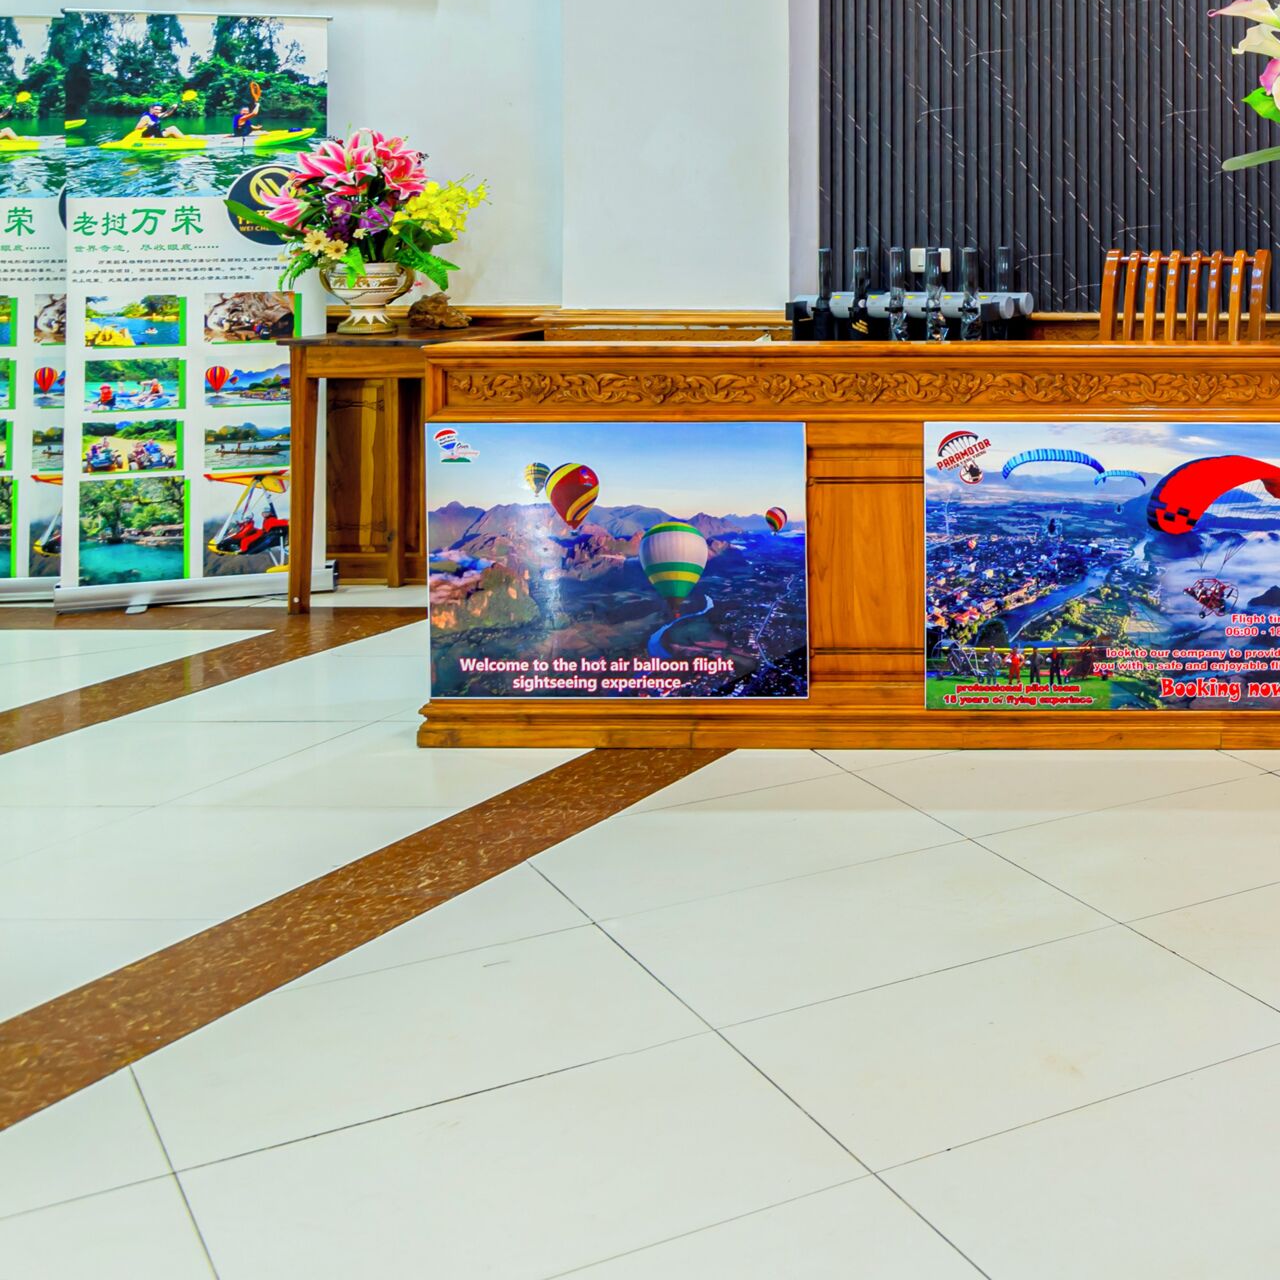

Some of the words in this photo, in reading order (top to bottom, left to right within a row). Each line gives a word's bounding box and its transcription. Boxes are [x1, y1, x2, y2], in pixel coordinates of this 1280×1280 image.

[4, 206, 35, 236] 荣
[73, 205, 203, 236] 老挝万荣
[936, 438, 991, 471] PARAMOTOR
[1232, 614, 1266, 624] Flight
[1226, 627, 1258, 636] 06:00
[1107, 648, 1132, 658] look
[1134, 649, 1147, 658] to
[1150, 650, 1169, 658] our
[1173, 649, 1226, 659] company
[1229, 649, 1241, 658] to
[460, 658, 528, 672] Welcome
[533, 659, 549, 672] to
[553, 658, 577, 672] the
[581, 658, 606, 672] hot
[610, 658, 630, 672] air
[634, 657, 688, 672] balloon
[693, 657, 734, 674] flight
[1094, 663, 1115, 672] you
[1118, 661, 1144, 670] with
[1147, 663, 1155, 671] a
[1158, 661, 1182, 671] safe
[1185, 661, 1207, 671] and
[1210, 661, 1267, 672] enjoyable
[513, 676, 597, 692] sightseeing
[956, 683, 1023, 694] professional
[1025, 684, 1049, 694] pilot
[1052, 684, 1080, 693] team
[1161, 678, 1241, 702] Booking
[960, 696, 990, 706] years
[992, 696, 1003, 704] of
[1007, 695, 1036, 706] flying
